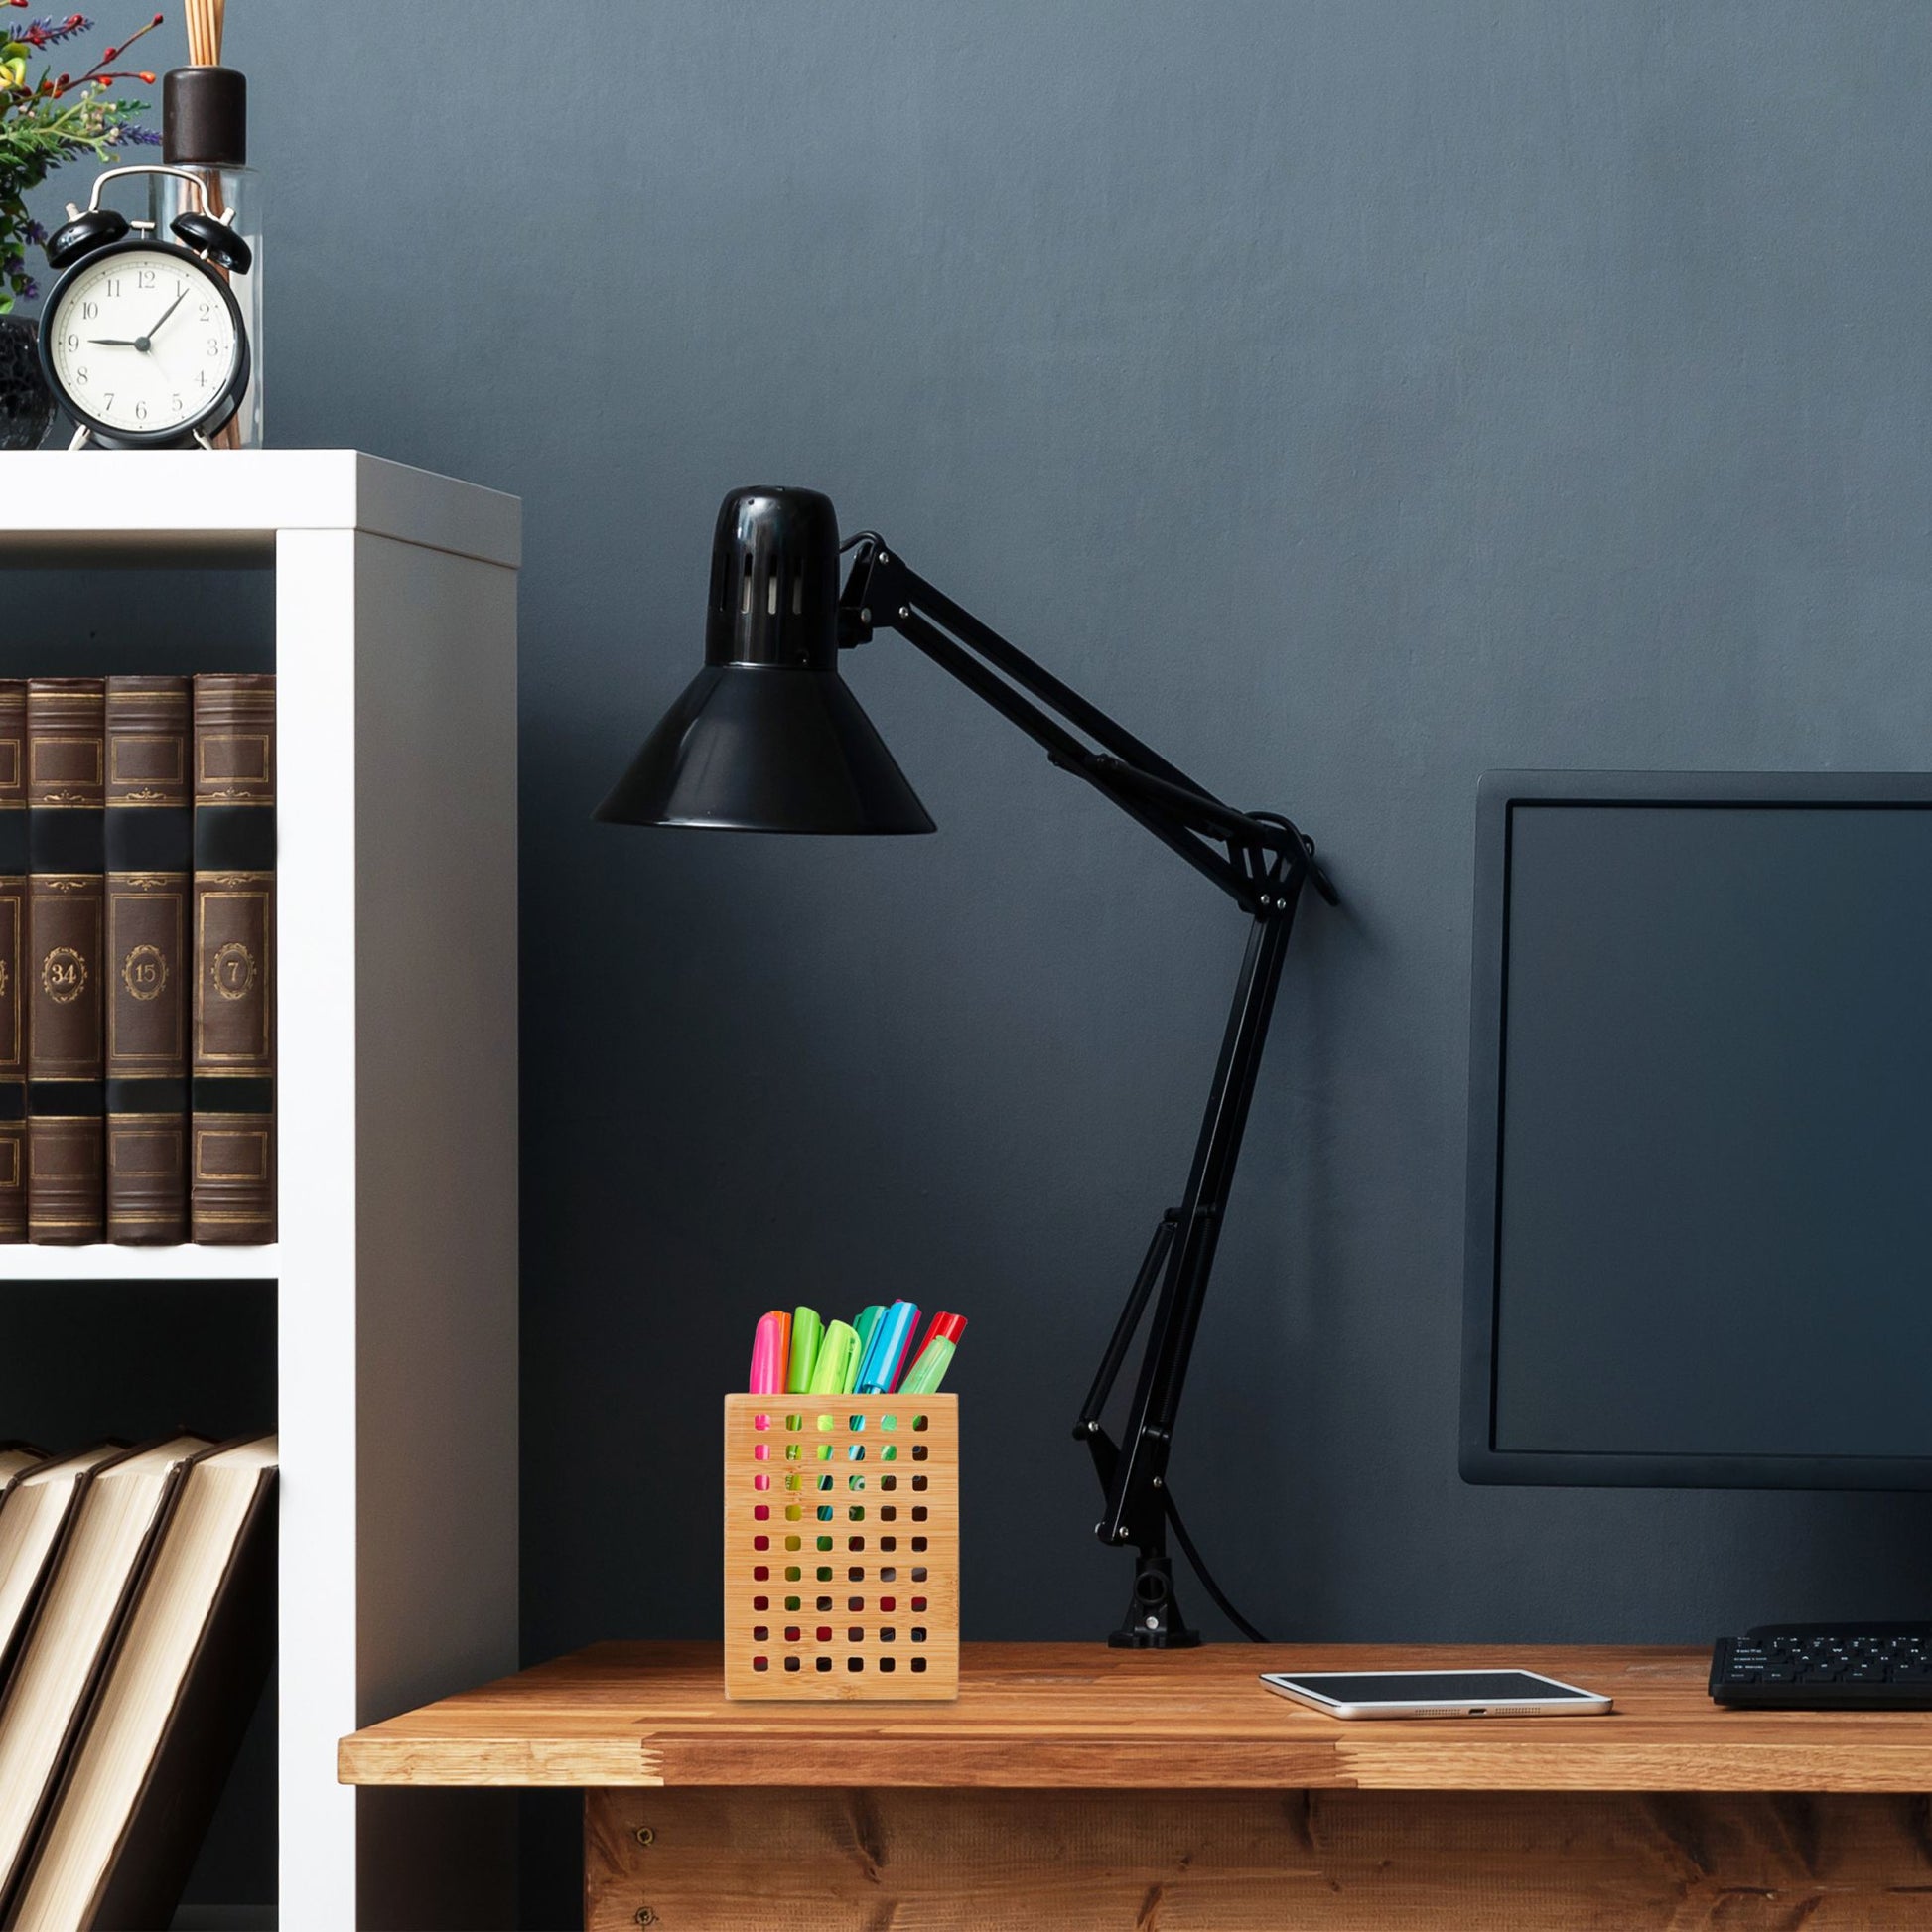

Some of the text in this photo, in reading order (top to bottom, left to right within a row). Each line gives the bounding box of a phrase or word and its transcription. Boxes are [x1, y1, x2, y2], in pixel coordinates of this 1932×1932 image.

[107, 279, 121, 297] 11
[138, 271, 156, 289] 12
[176, 280, 182, 297] 1
[83, 302, 98, 319] 10
[199, 304, 209, 322] 2
[68, 334, 79, 352] 9
[207, 339, 218, 356] 3
[77, 366, 88, 385] 8
[195, 370, 207, 387] 4
[104, 393, 114, 411] 7
[135, 401, 147, 419] 6
[172, 394, 183, 412] 5
[51, 962, 77, 984] 34
[135, 964, 156, 983] 15
[227, 961, 239, 982] 7
